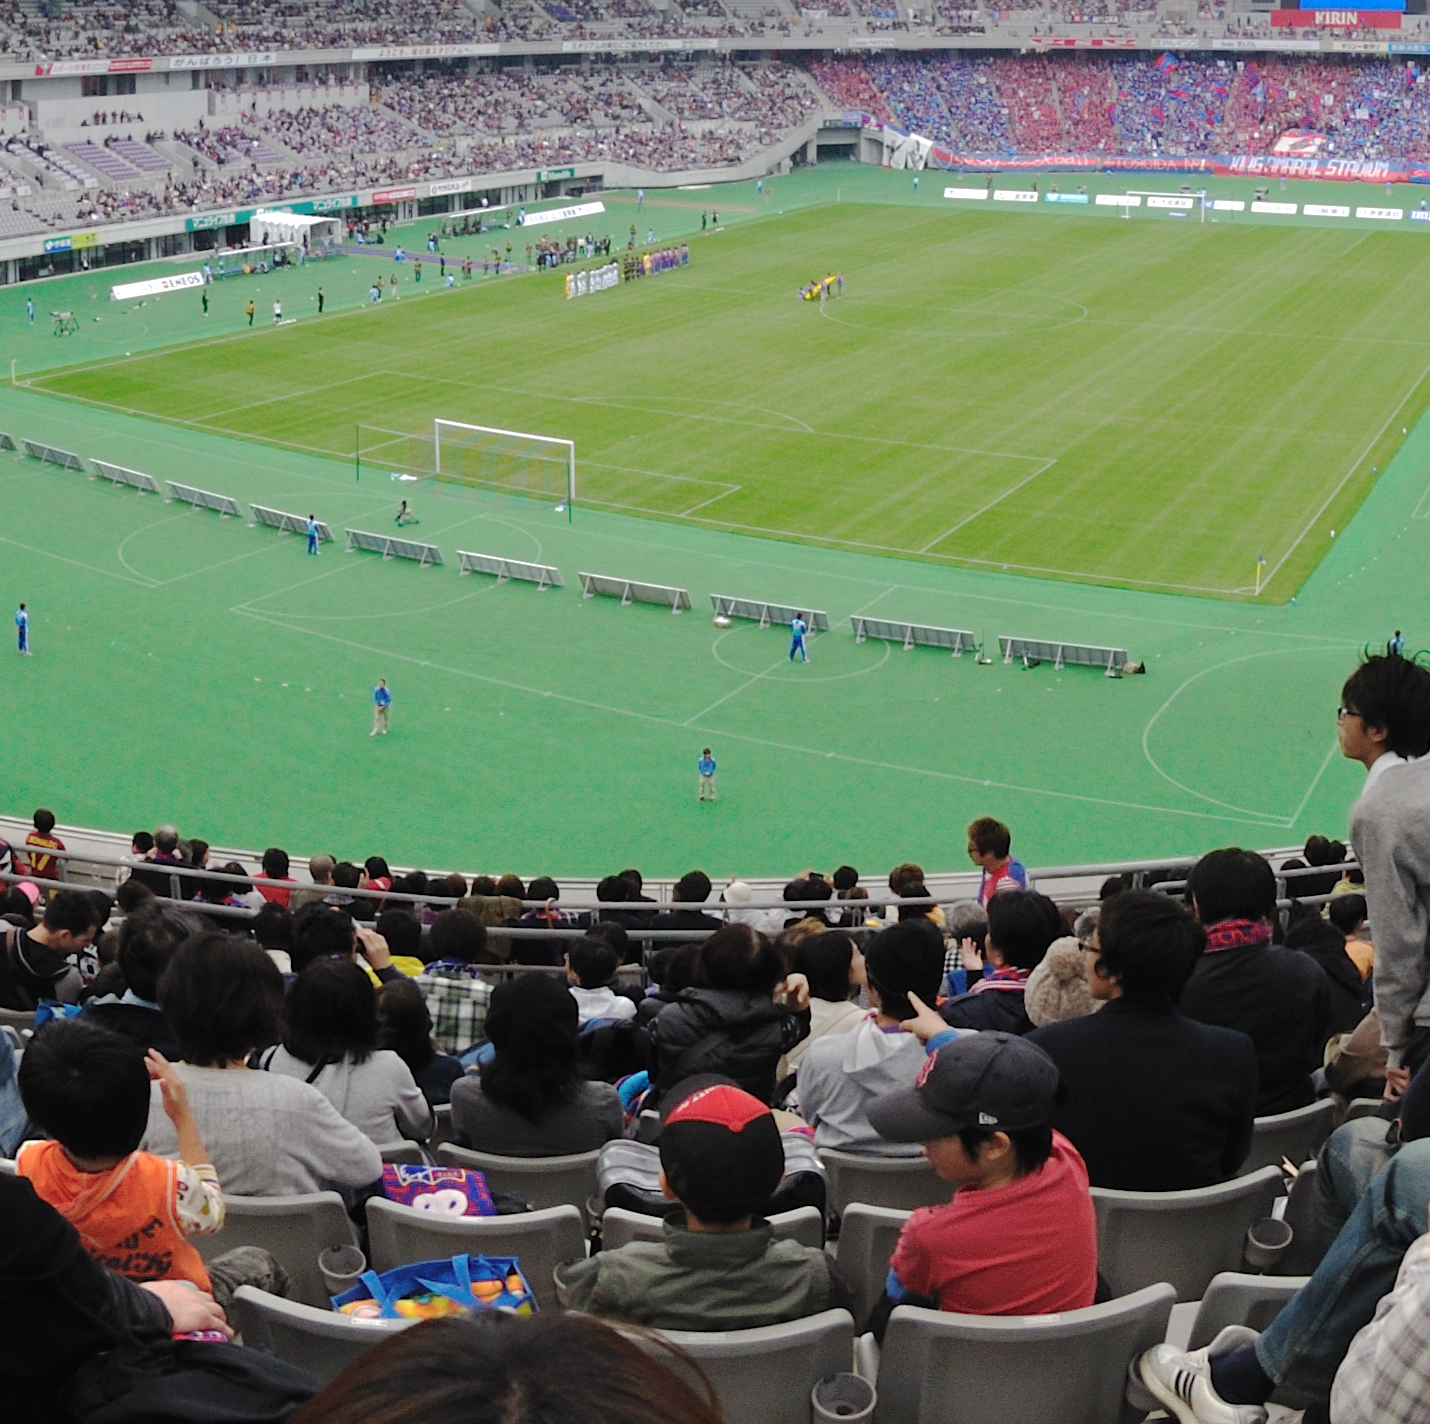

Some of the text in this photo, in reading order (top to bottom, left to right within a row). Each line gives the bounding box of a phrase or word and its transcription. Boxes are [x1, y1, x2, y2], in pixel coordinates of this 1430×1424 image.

[1315, 11, 1357, 24] KIRIN
[1325, 160, 1389, 177] STADIUM
[169, 274, 200, 288] ENEOS
